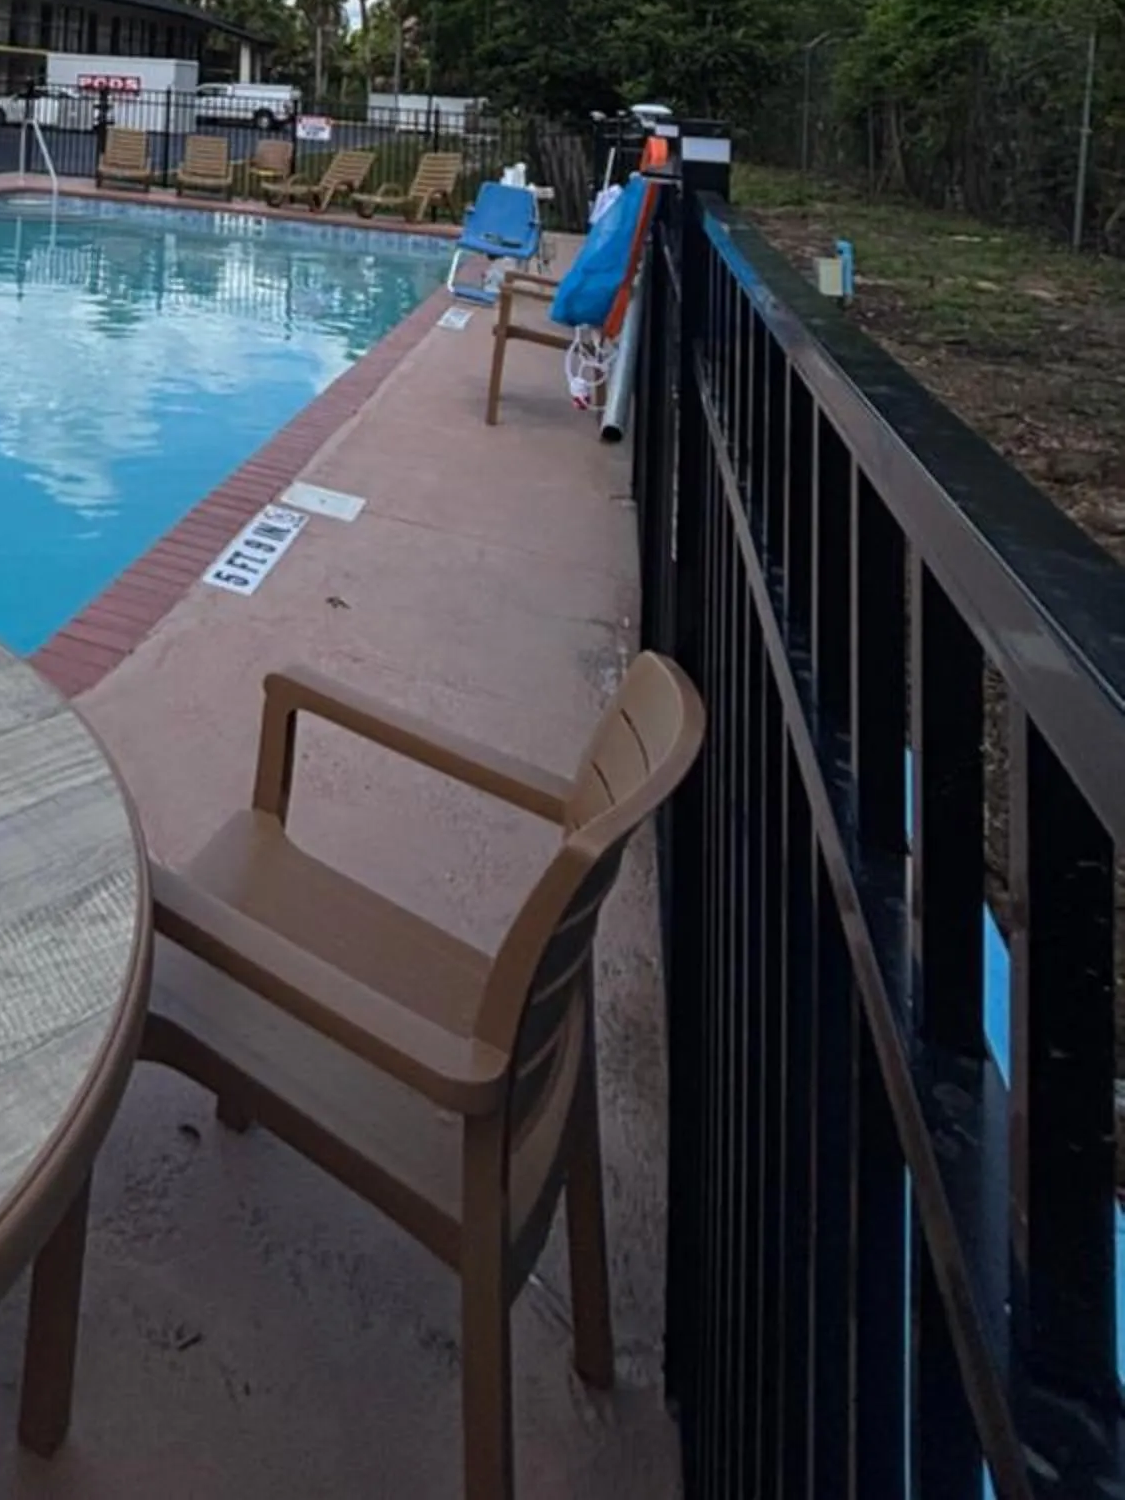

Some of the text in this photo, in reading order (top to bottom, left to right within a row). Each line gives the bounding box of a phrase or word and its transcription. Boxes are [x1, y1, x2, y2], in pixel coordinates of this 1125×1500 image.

[78, 76, 138, 90] PODS
[225, 550, 268, 575] FT
[213, 570, 250, 587] 5
